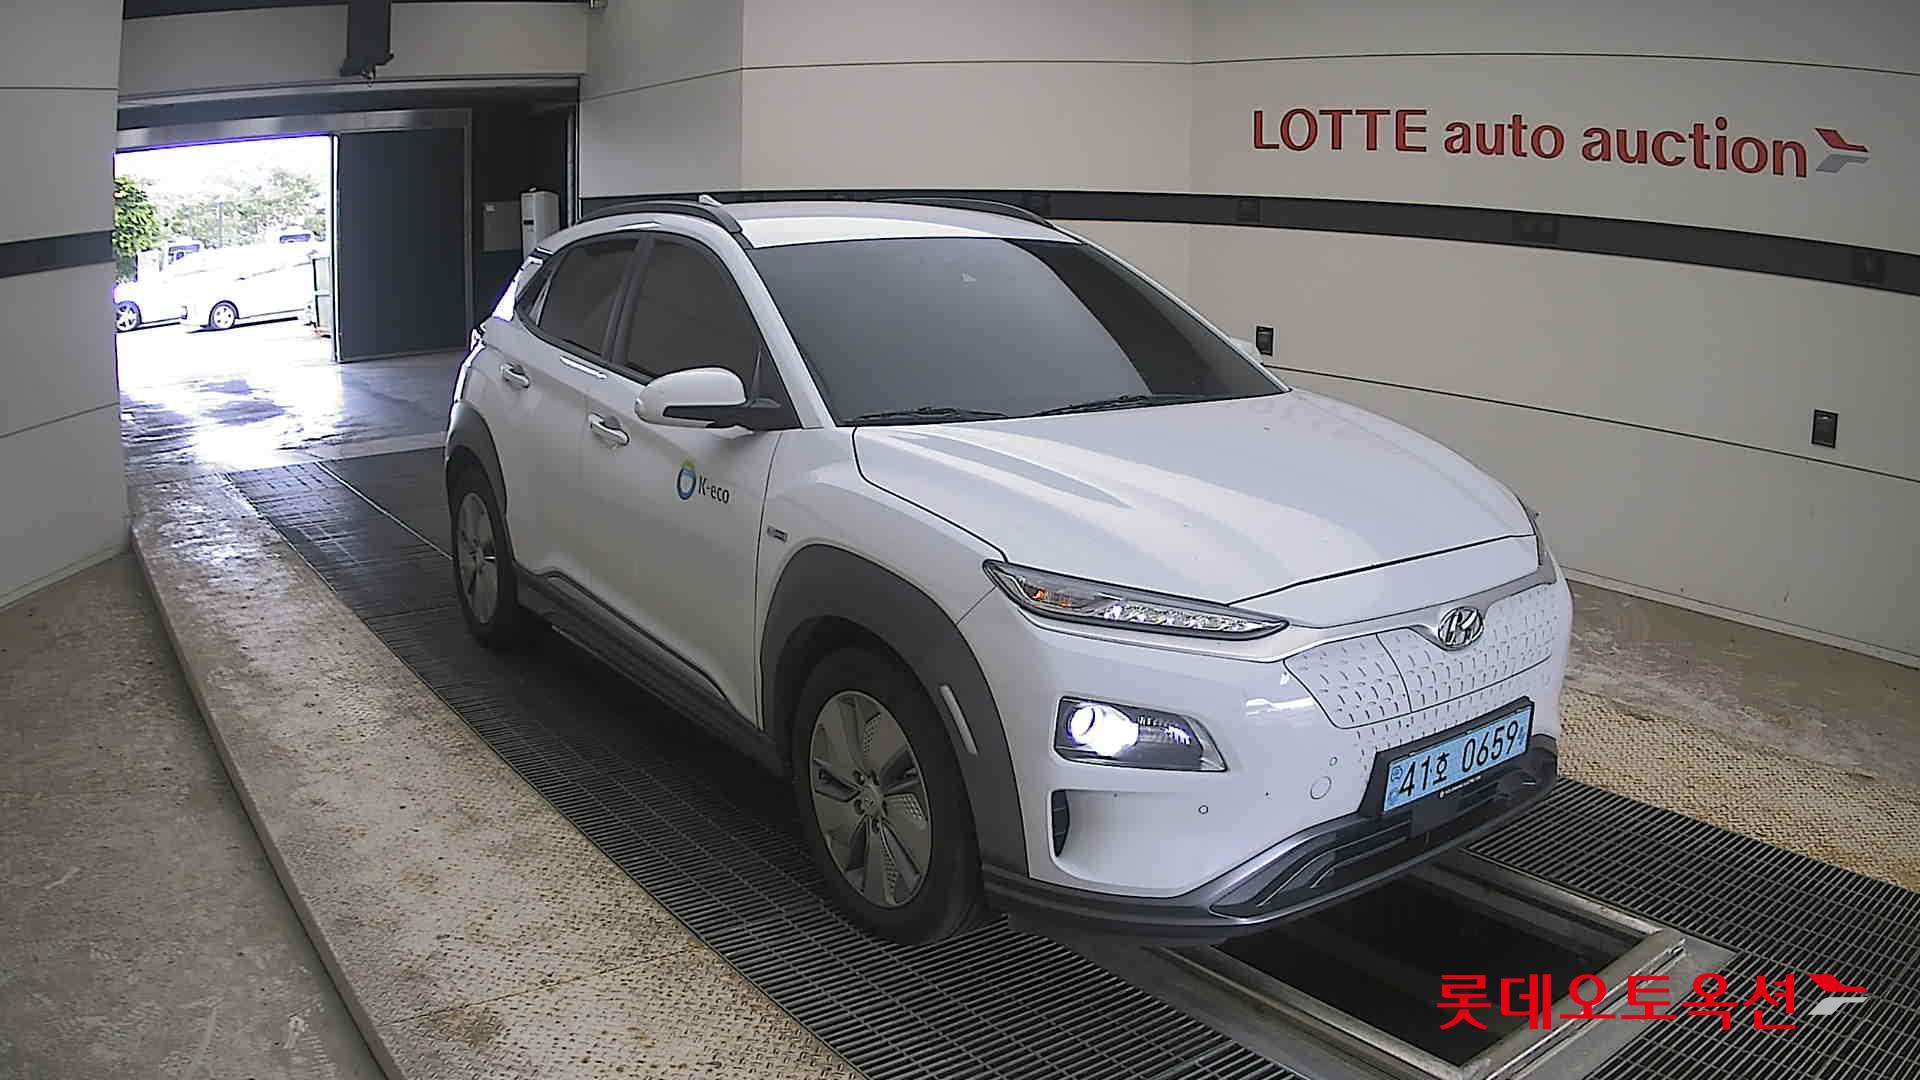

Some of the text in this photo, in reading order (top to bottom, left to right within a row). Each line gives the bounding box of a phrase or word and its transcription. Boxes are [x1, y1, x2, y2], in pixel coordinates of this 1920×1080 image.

[1253, 108, 1808, 178] LOTTE auto auction
[699, 475, 730, 504] K-eco
[1399, 752, 1449, 796] 41호
[1462, 720, 1519, 773] 0659
